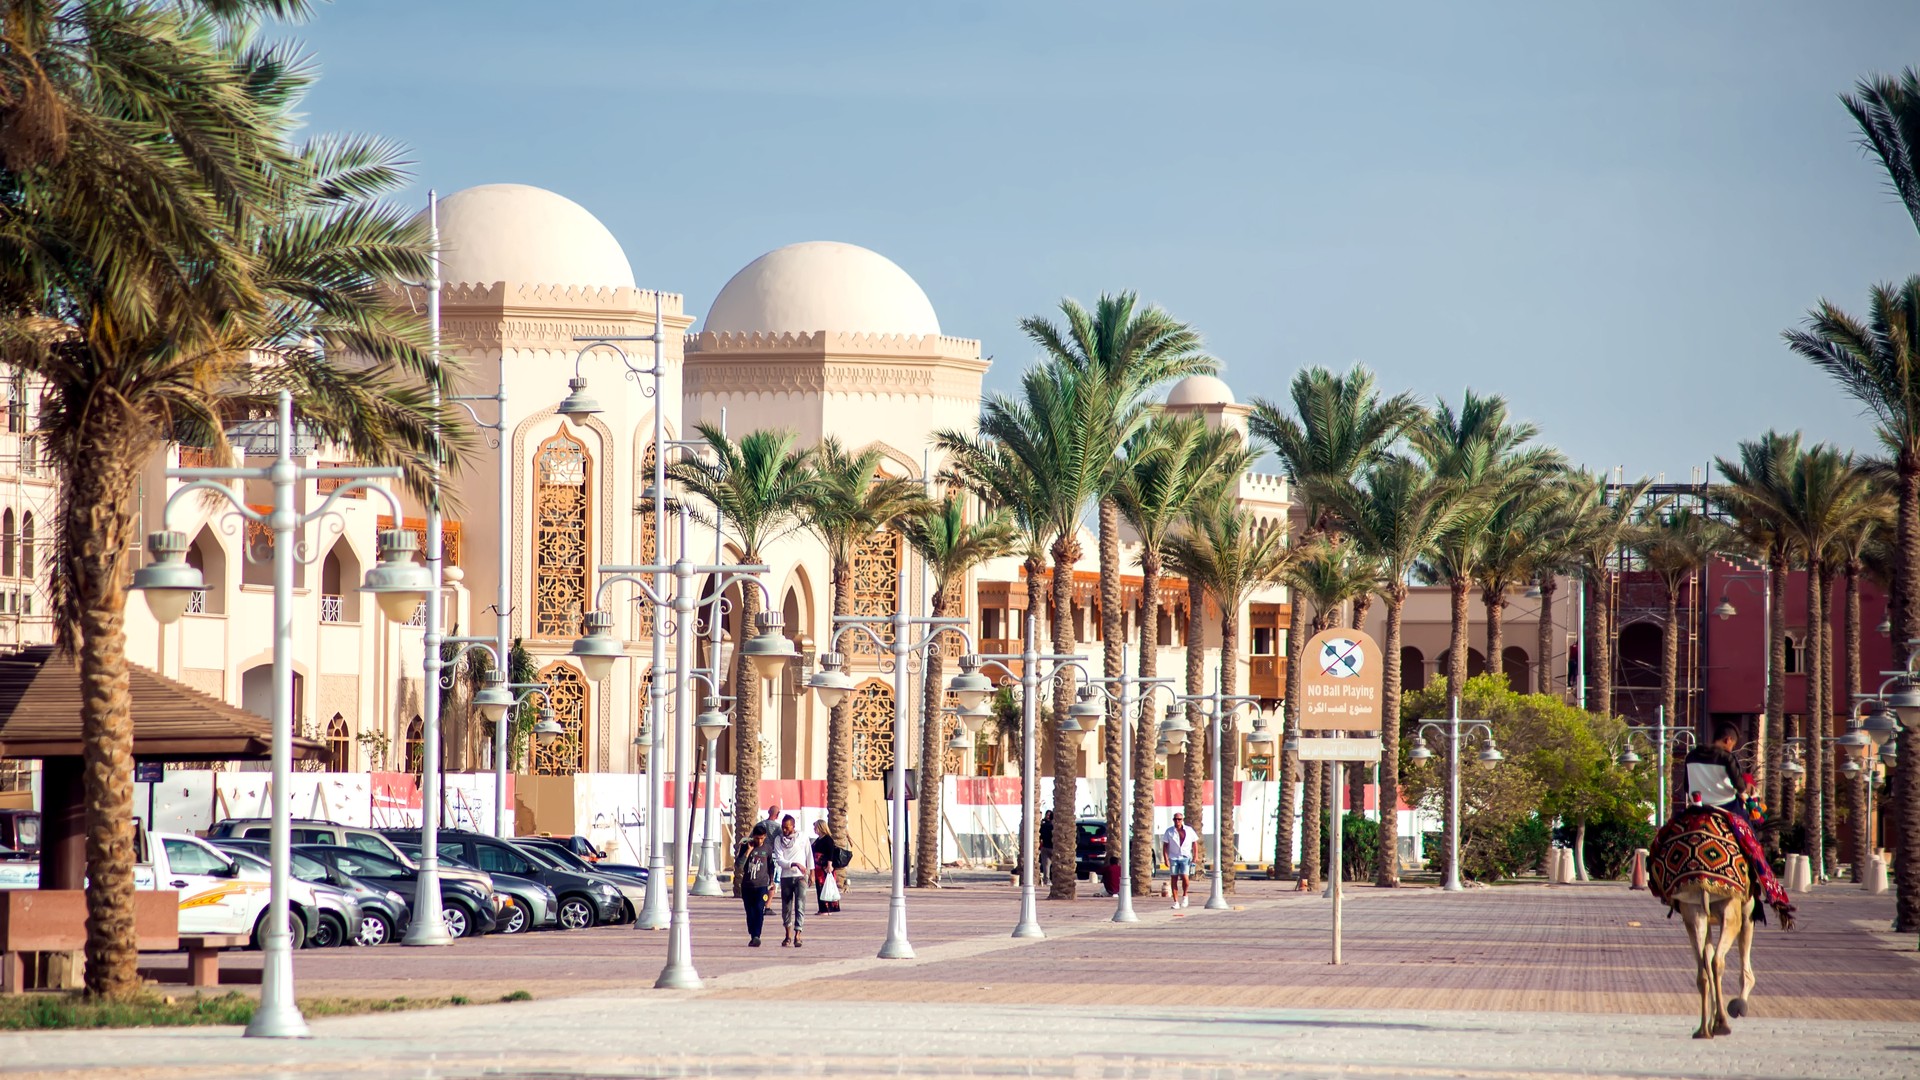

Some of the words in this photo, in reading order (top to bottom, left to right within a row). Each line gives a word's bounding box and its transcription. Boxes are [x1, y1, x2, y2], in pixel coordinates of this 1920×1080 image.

[1308, 684, 1321, 696] NO
[1323, 684, 1339, 696] Ball
[1342, 684, 1374, 699] Playing
[1308, 702, 1326, 714] الكرة
[1327, 702, 1346, 715] لعب
[1349, 704, 1372, 715] ممنوع
